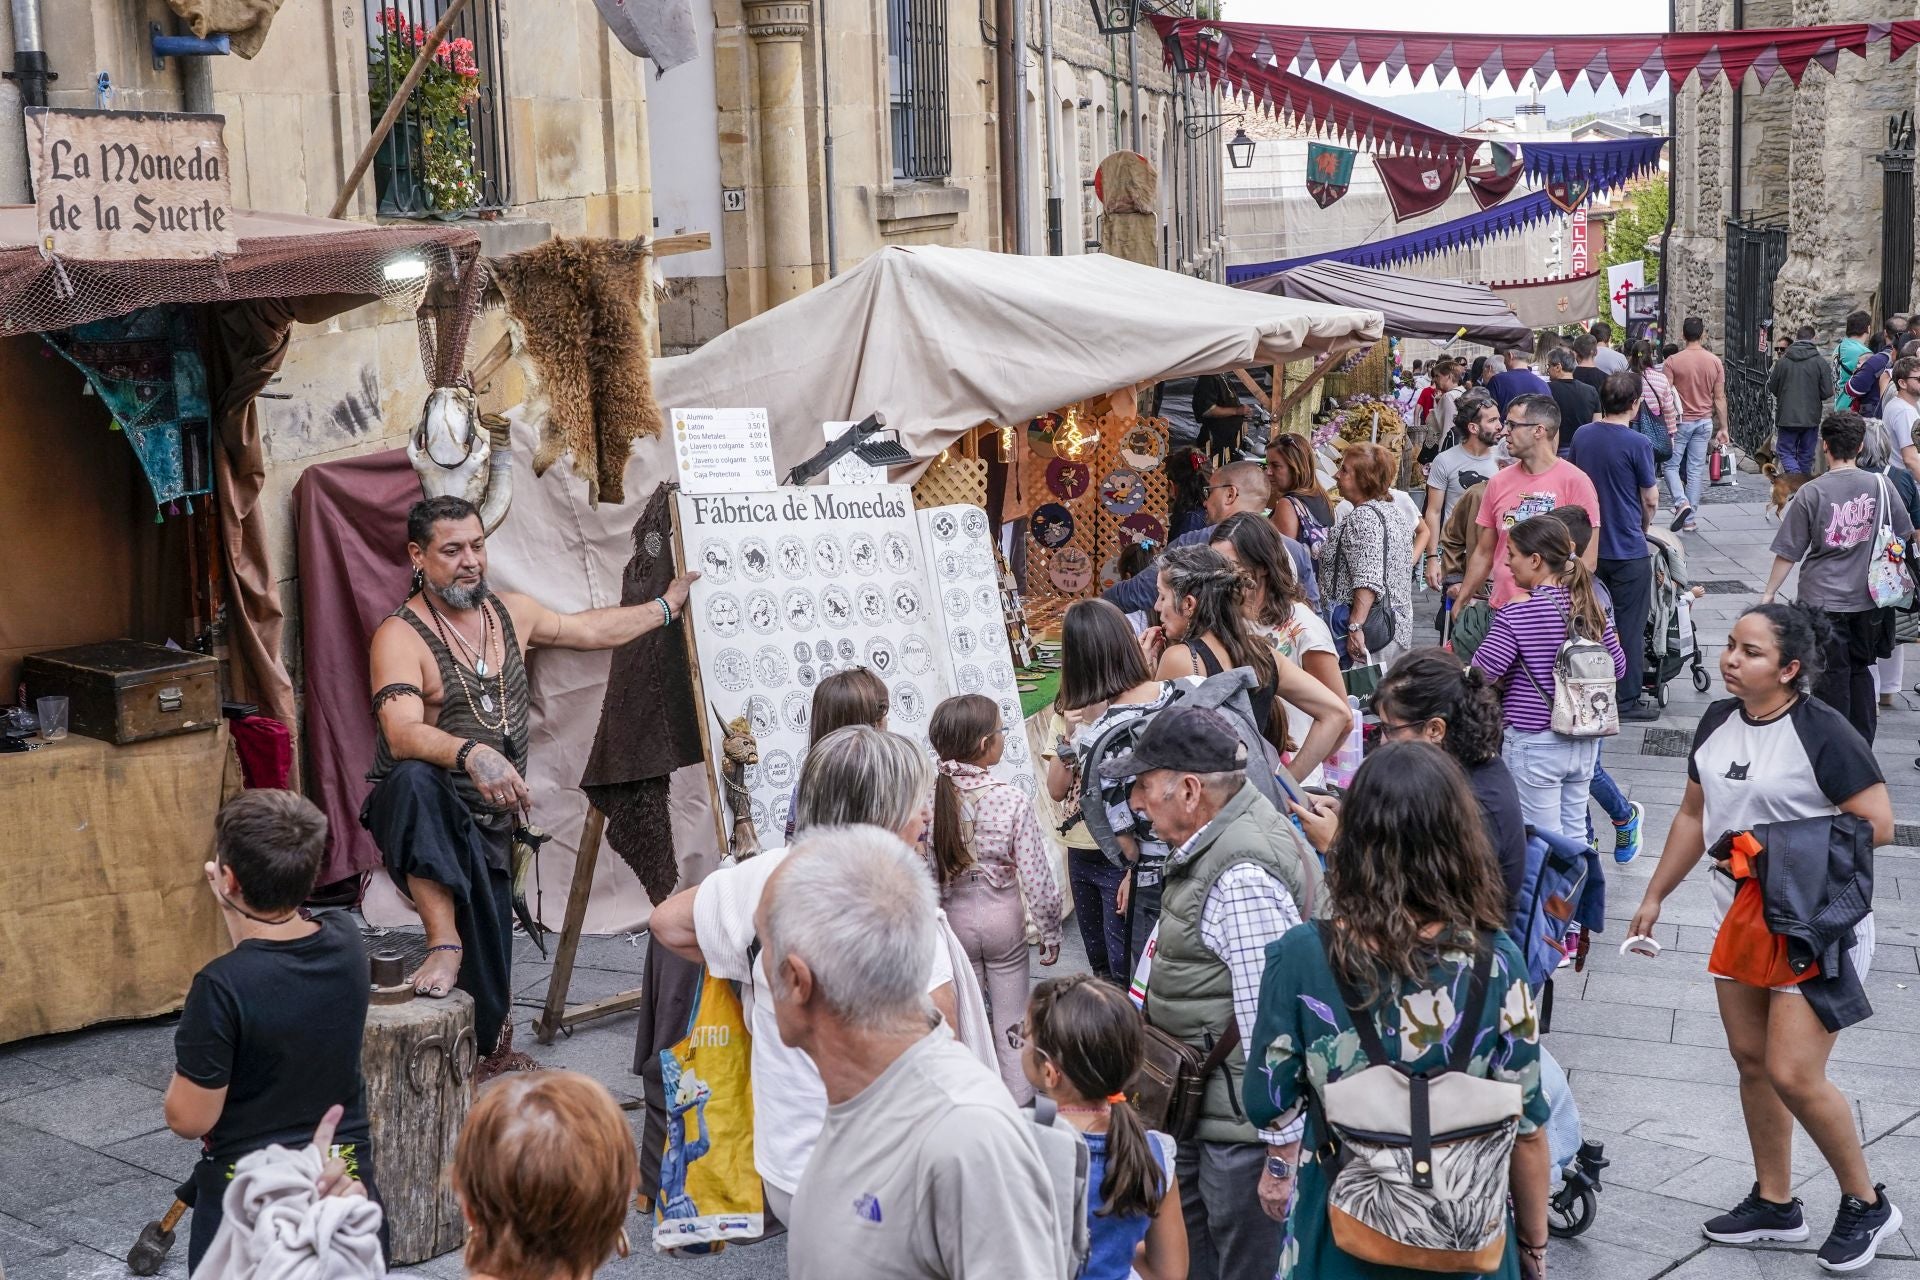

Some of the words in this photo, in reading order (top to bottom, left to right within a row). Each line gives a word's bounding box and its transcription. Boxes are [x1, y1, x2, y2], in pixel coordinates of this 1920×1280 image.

[51, 139, 91, 182] La
[100, 142, 220, 184] Moneda
[728, 192, 740, 208] 9
[50, 194, 82, 231] de
[93, 195, 121, 231] la
[132, 193, 225, 234] Suerte
[686, 413, 714, 421] Aluminio
[701, 432, 726, 440] Metales
[719, 441, 745, 451] colgante
[720, 456, 747, 465] colgante
[693, 471, 708, 480] Caja
[709, 470, 741, 478] Protectora
[691, 496, 778, 525] Fábrica
[782, 494, 809, 521] de
[811, 492, 906, 520] Monedas
